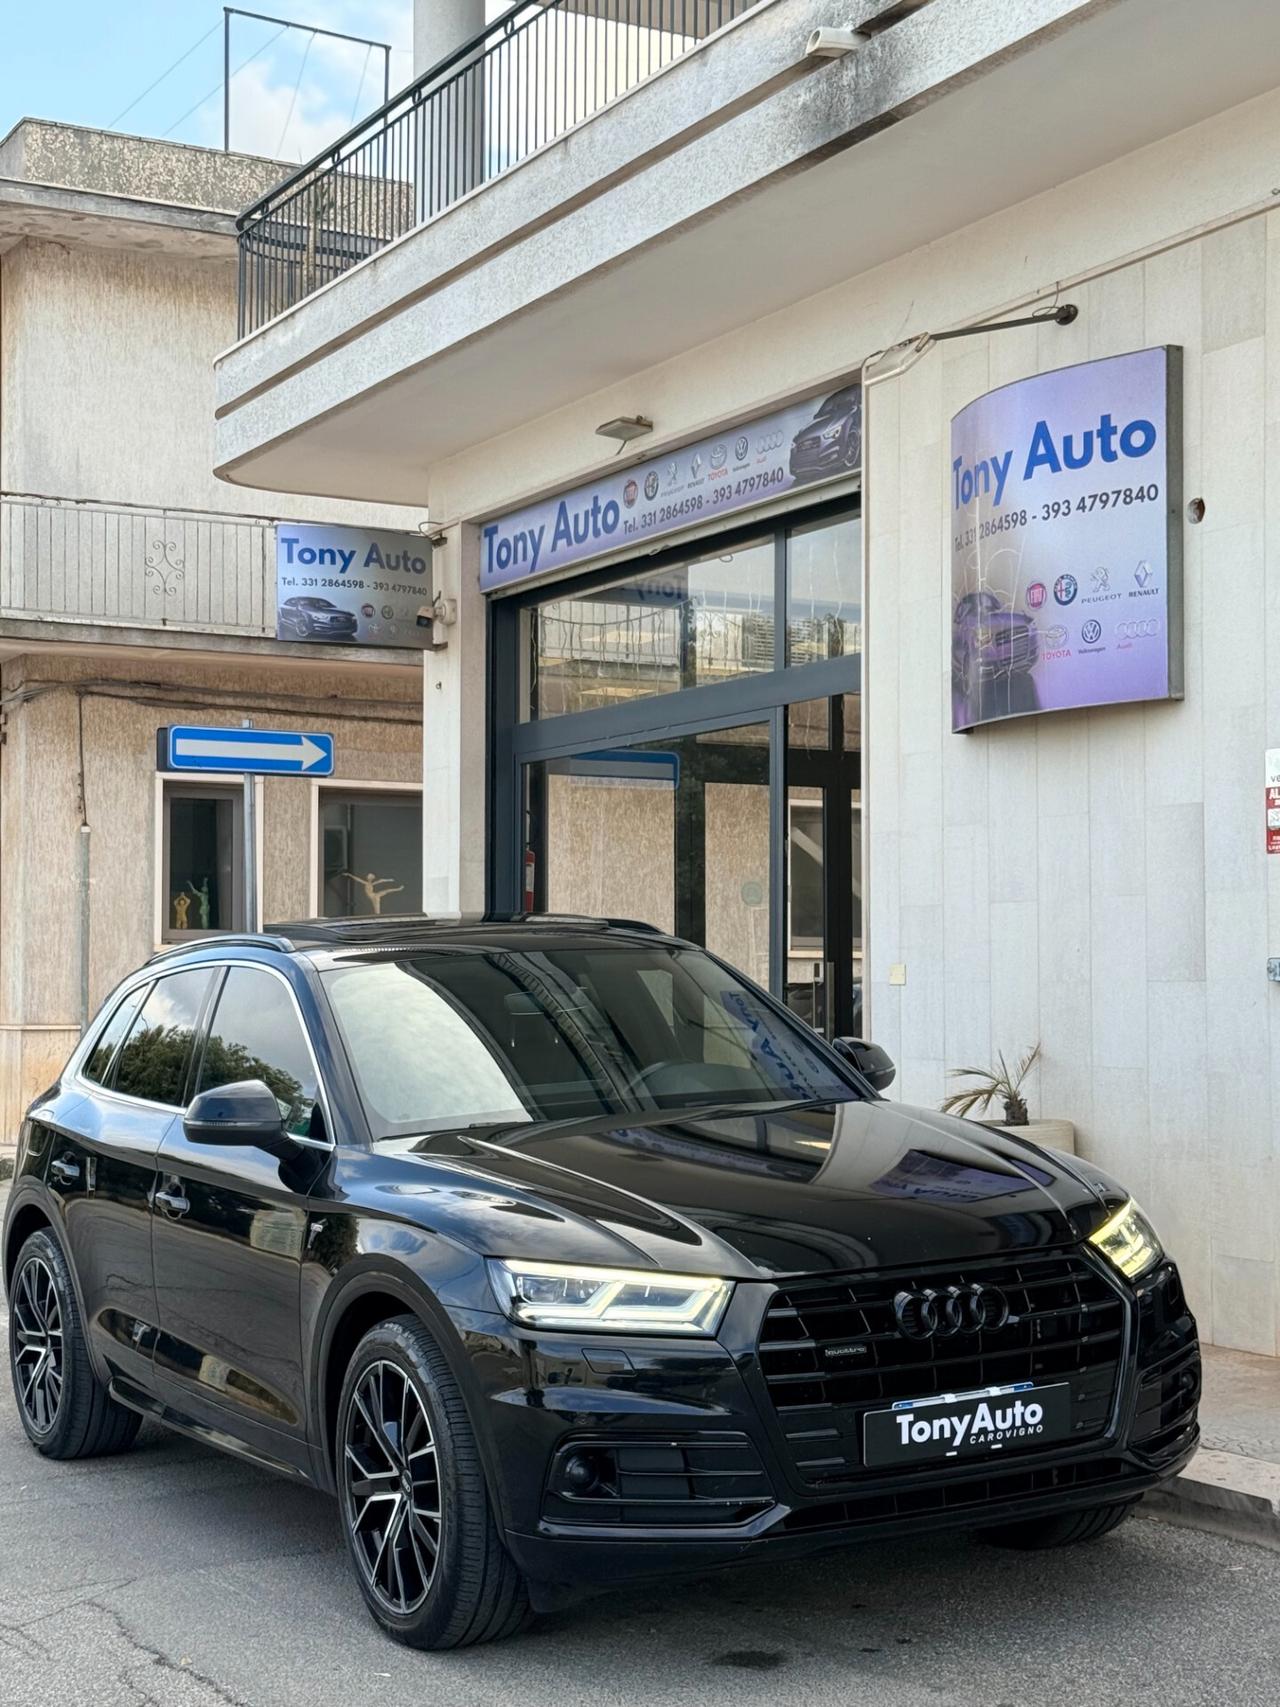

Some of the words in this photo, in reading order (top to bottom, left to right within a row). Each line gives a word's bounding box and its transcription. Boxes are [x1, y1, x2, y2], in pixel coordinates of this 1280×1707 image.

[952, 450, 1014, 510] Tony
[1023, 414, 1157, 480] Auto
[624, 517, 639, 535] Tel.
[641, 510, 657, 528] 331
[660, 495, 703, 523] 2864598
[713, 485, 732, 504] 393
[735, 466, 784, 496] 4797840
[979, 509, 1028, 540] 2864598
[1042, 500, 1071, 522] 393
[1076, 484, 1159, 513] 4797840
[281, 537, 357, 574] Tony
[363, 542, 427, 575] Auto
[484, 525, 545, 574] Tony
[551, 495, 620, 552] Auto
[282, 577, 299, 587] Tel.
[301, 578, 318, 587] 331
[321, 579, 364, 590] 2864598
[1041, 649, 1071, 661] TOYOTA
[896, 1400, 1043, 1447] TonyAuto
[970, 1425, 1043, 1444] CAROVIGNO
